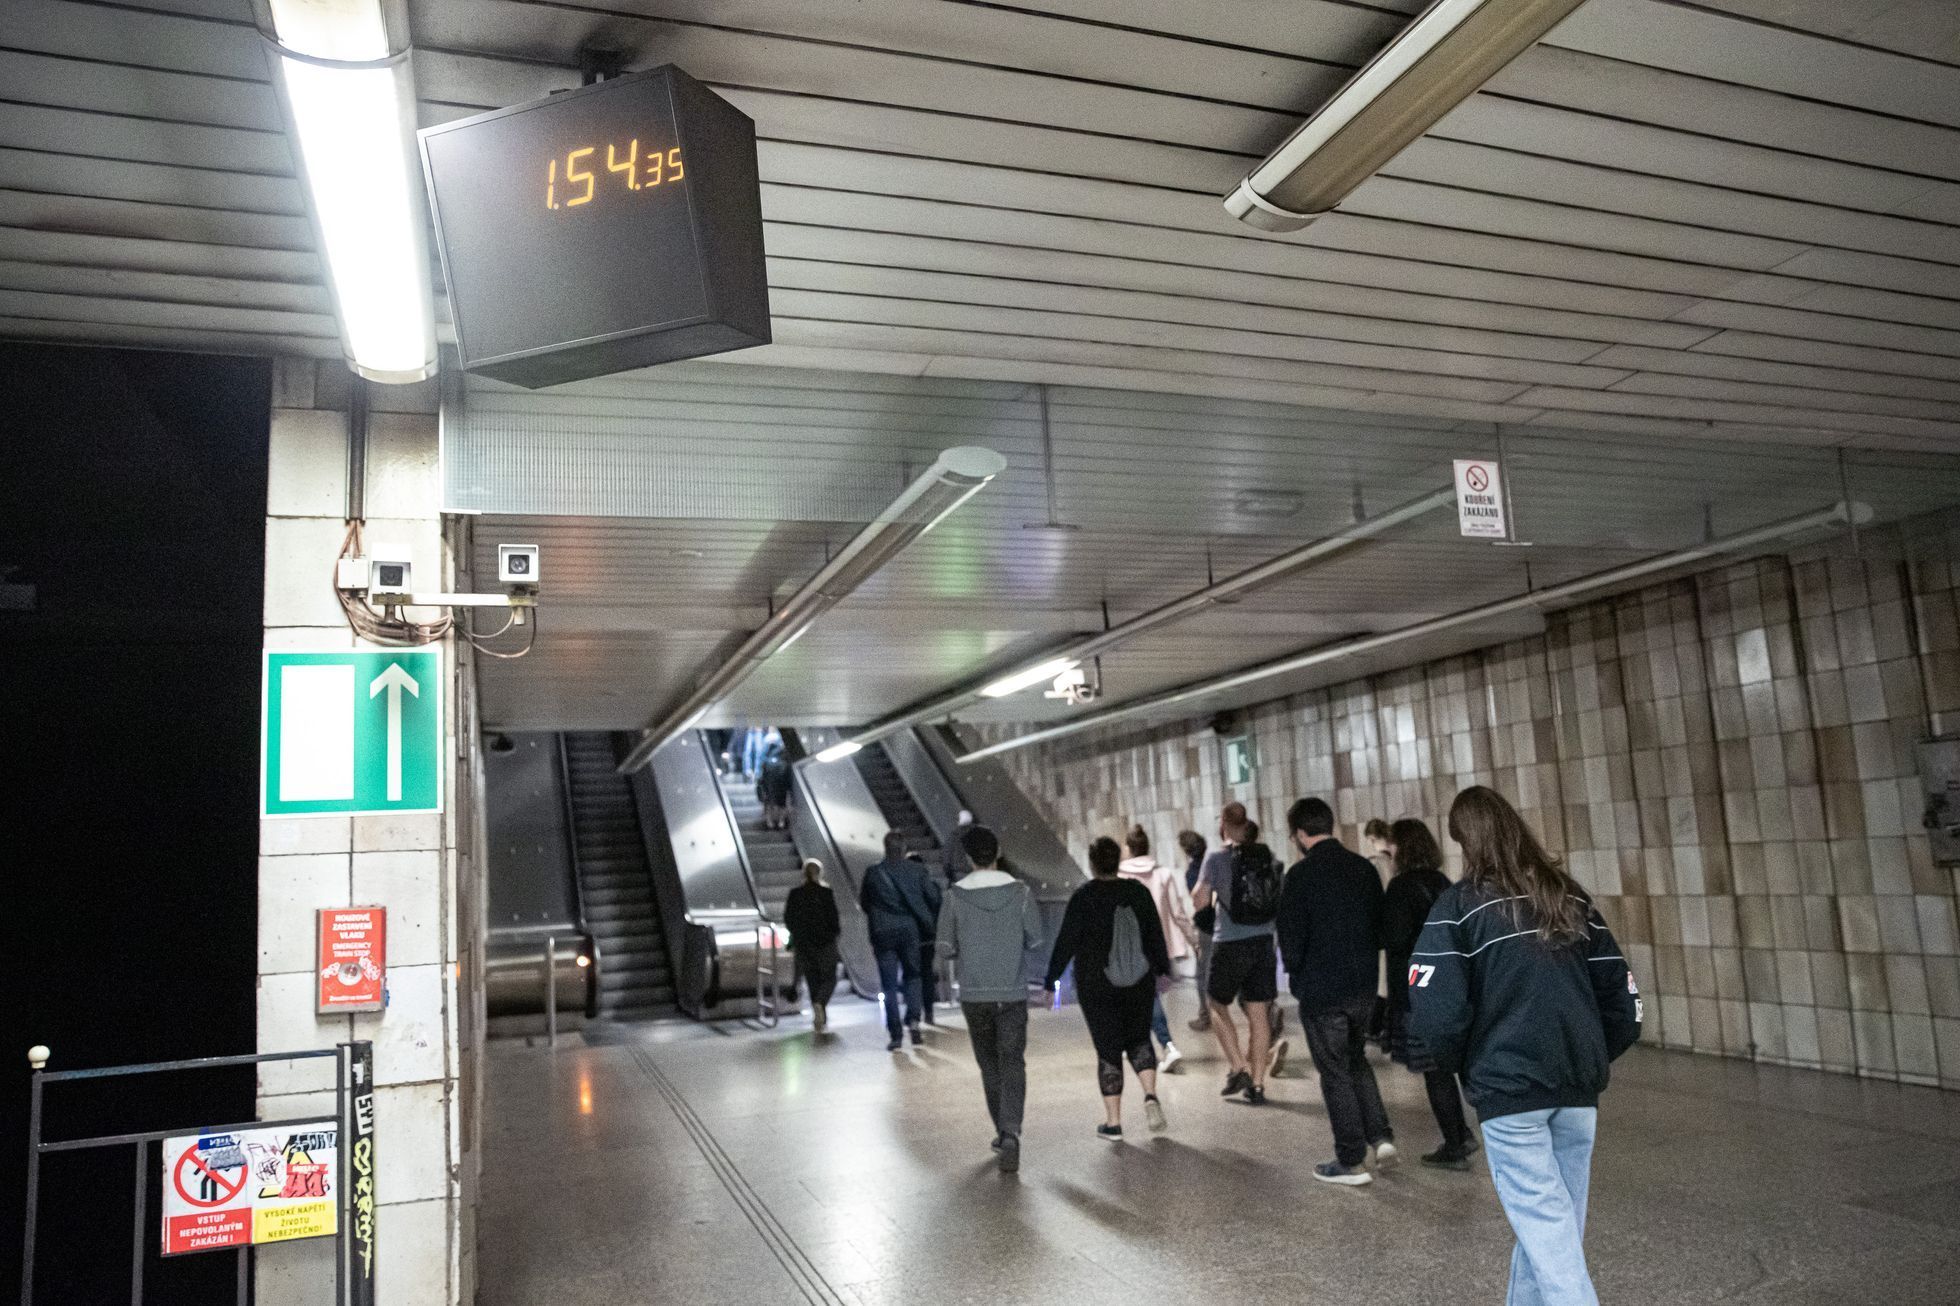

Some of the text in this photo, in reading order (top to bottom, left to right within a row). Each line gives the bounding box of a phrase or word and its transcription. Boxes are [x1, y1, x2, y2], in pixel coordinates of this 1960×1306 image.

[264, 1203, 326, 1218] VYSOKÉ NAPĚTÍ
[197, 1213, 227, 1225] VSTUP
[280, 1216, 311, 1227] ŽIVOTU
[179, 1222, 244, 1238] NEPOVOLANÝM
[268, 1224, 323, 1238] NEBEZPEČNO!
